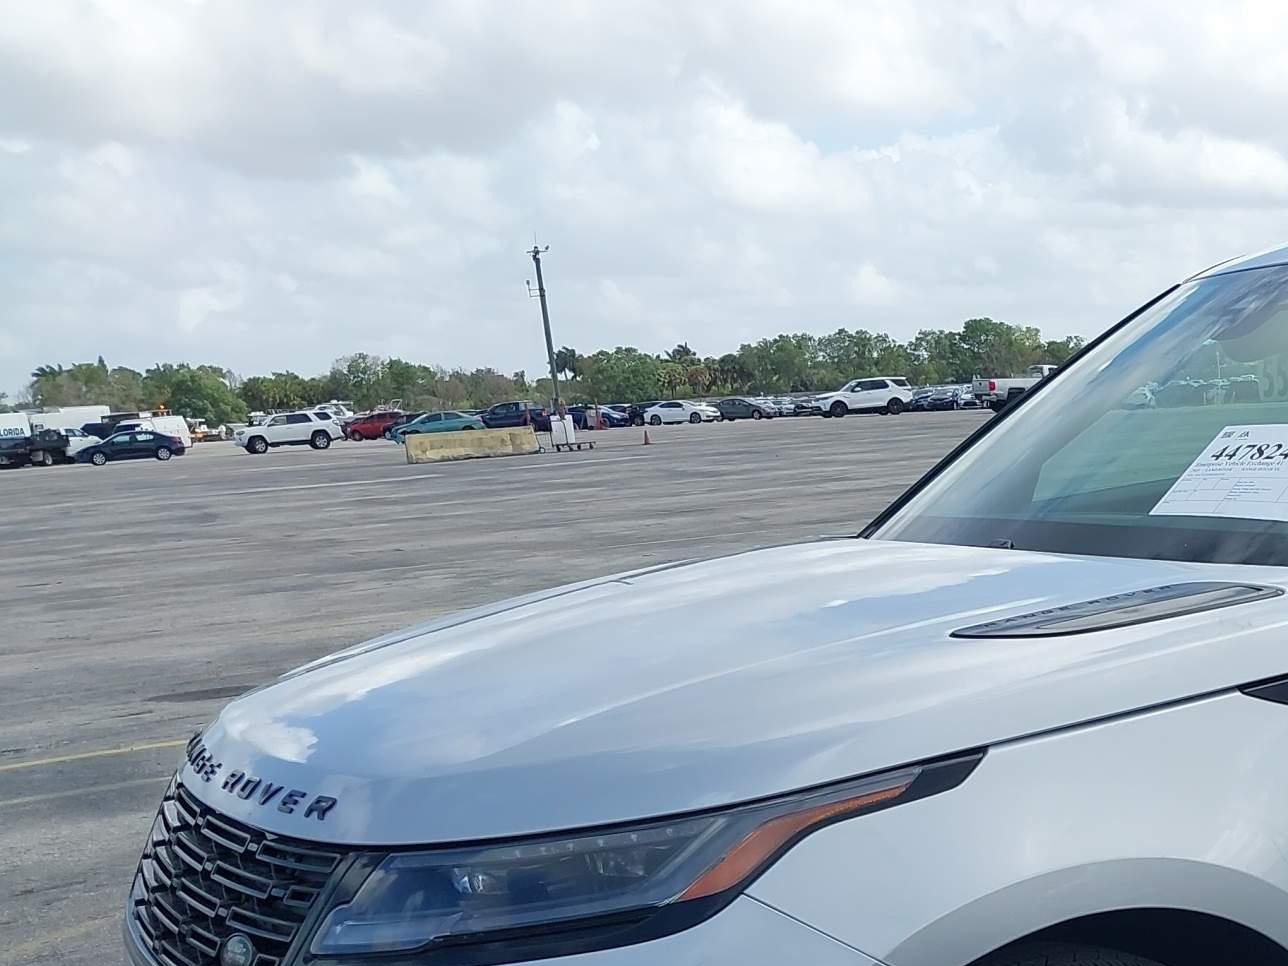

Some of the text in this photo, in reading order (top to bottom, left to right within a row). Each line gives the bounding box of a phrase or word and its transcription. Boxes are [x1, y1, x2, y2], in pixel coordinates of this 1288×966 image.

[983, 584, 1171, 628] RANGE ROVER
[222, 769, 338, 821] ROVER
